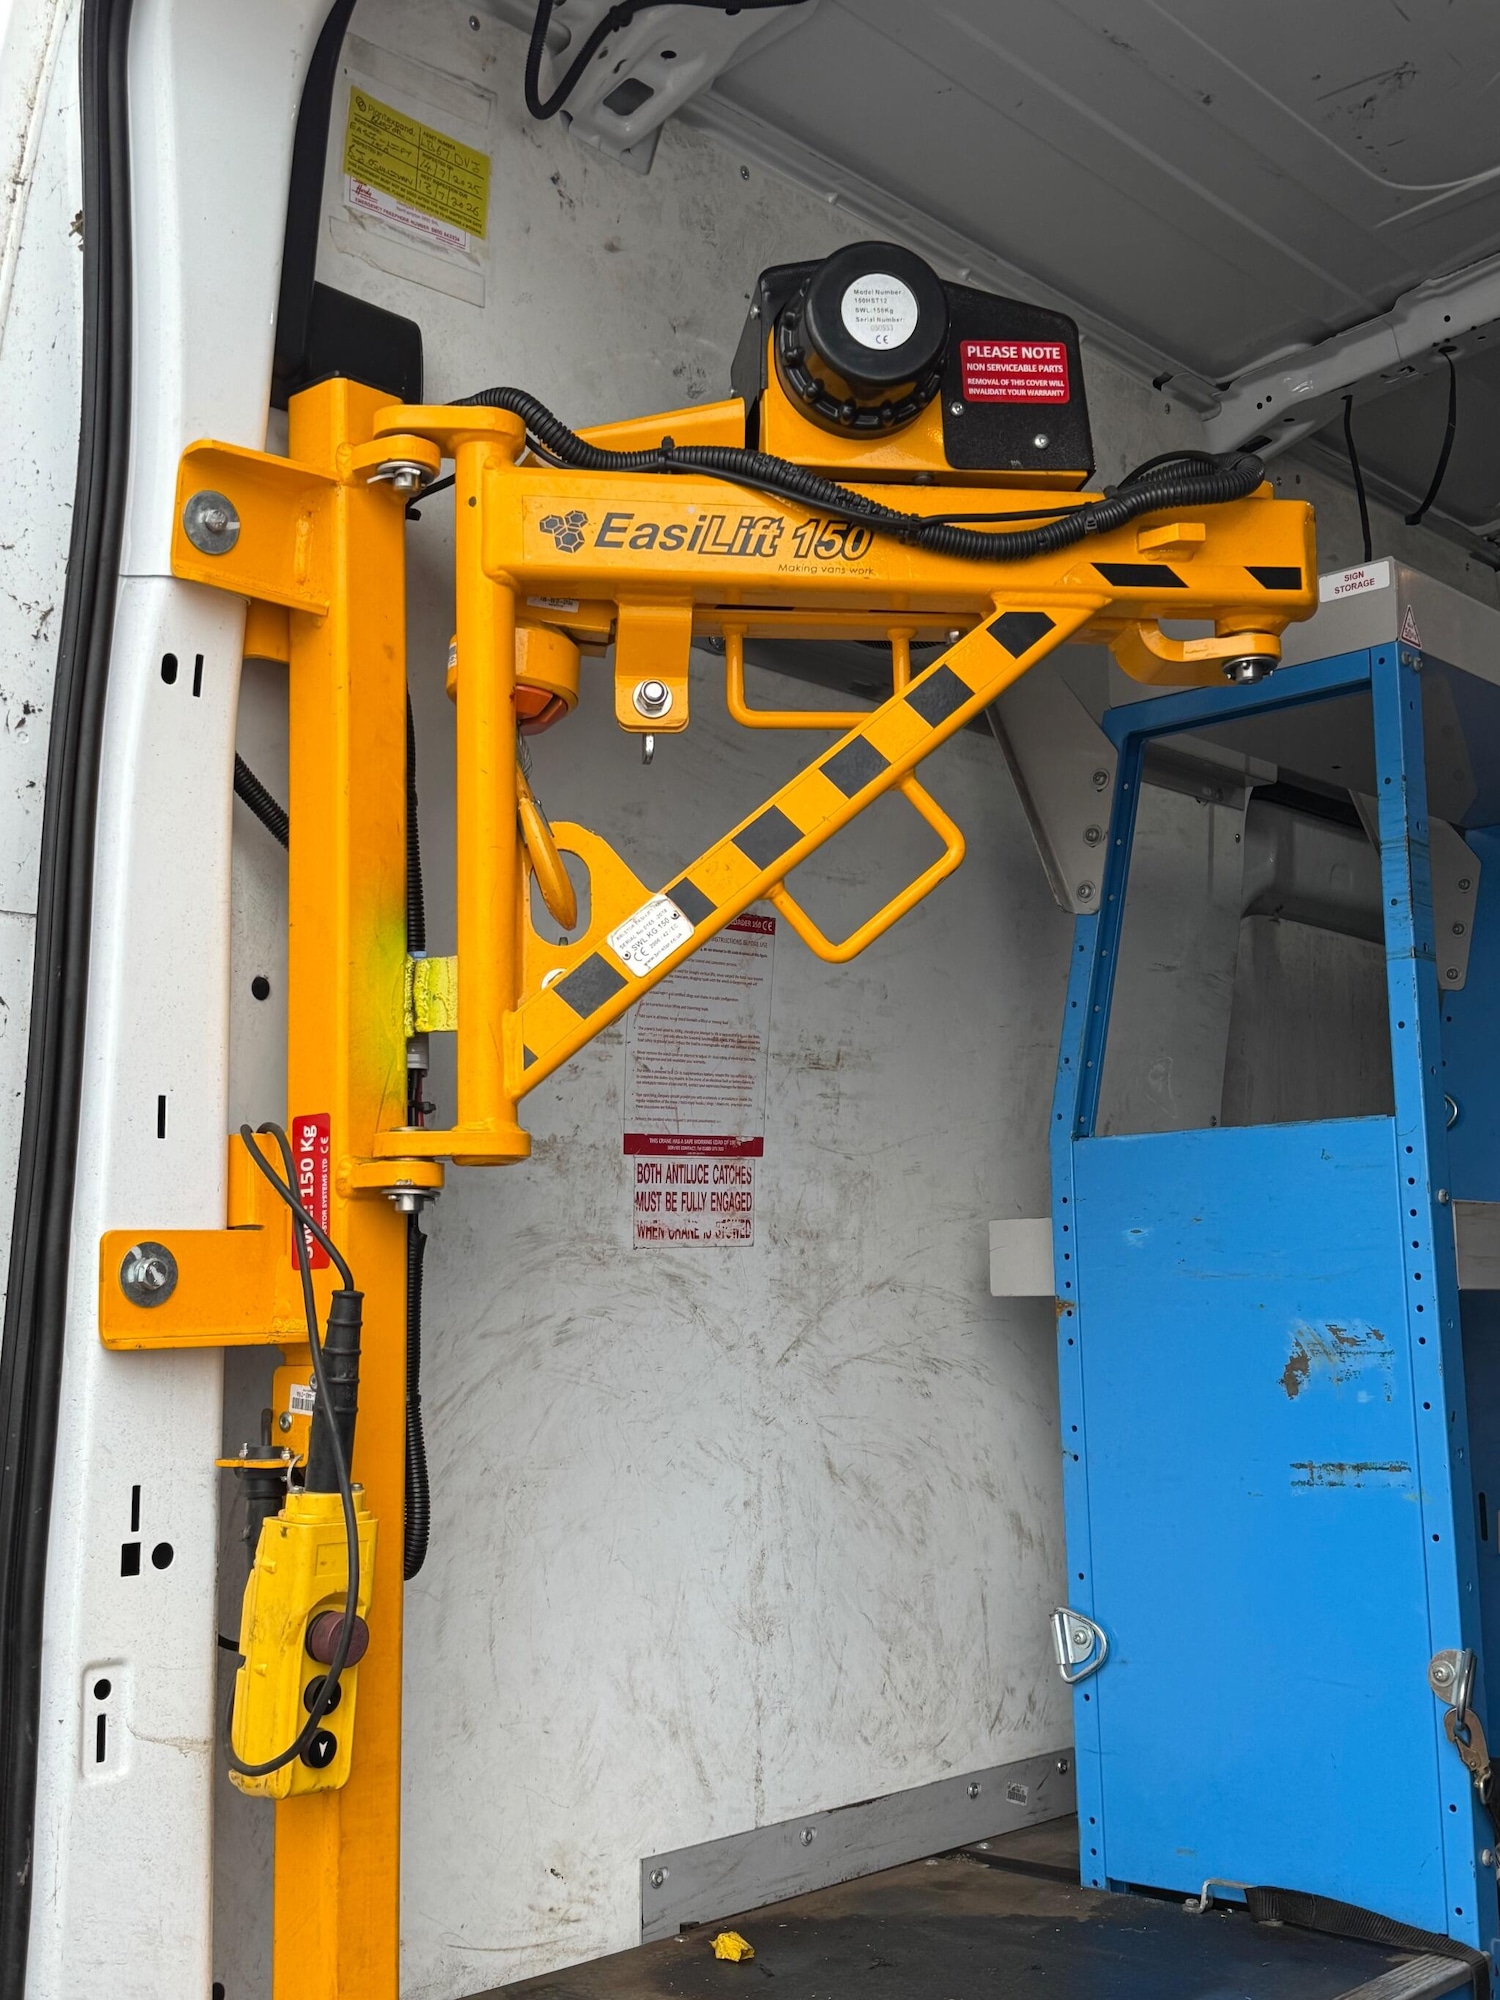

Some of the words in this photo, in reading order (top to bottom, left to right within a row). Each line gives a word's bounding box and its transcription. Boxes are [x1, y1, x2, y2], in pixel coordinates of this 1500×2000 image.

[967, 346, 1018, 358] PLEASE
[1022, 347, 1061, 359] NOTE
[967, 363, 985, 371] NON
[987, 364, 1037, 372] SERVICEABLE
[1038, 365, 1064, 373] PARTS
[967, 378, 1000, 386] REMOVAL
[593, 512, 784, 558] EasiLift
[791, 518, 876, 561] 150
[777, 563, 818, 575] Making
[821, 565, 847, 574] vans
[1344, 570, 1365, 582] SIGN
[1334, 578, 1375, 594] STORAGE
[629, 935, 648, 951] SWL
[645, 926, 659, 939] KG
[656, 916, 671, 929] 150
[299, 1124, 318, 1153] Kg
[300, 1157, 314, 1198] 150
[637, 1163, 662, 1184] BOTH
[665, 1163, 709, 1184] ANTILUCE
[712, 1164, 752, 1185] CATCHES
[635, 1191, 662, 1212] MUST
[665, 1191, 677, 1212] BE
[681, 1191, 708, 1212] FULLY
[710, 1191, 753, 1212] ENGAGED
